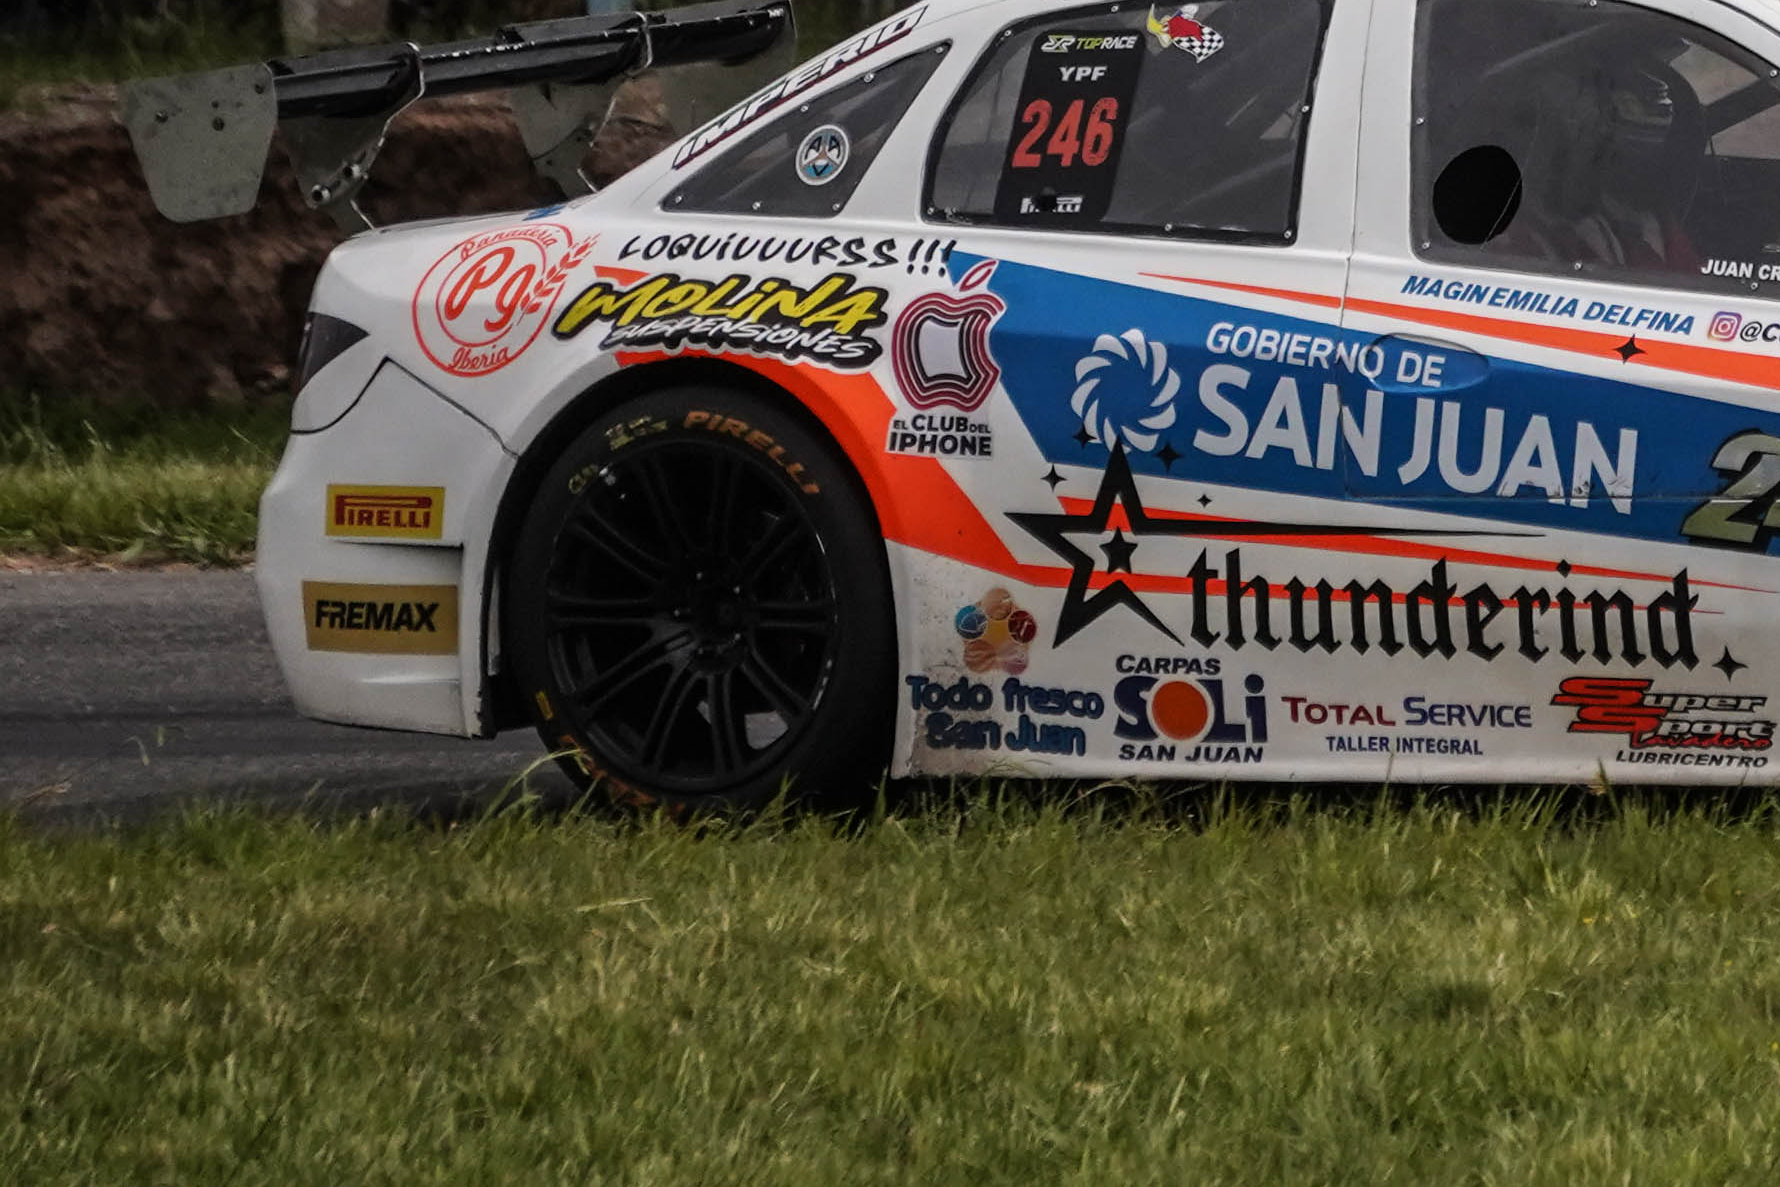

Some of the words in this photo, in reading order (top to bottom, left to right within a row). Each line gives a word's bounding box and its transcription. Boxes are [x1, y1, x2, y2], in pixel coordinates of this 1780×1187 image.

[1059, 66, 1107, 81] YPF
[1012, 97, 1119, 167] 246
[1700, 259, 1752, 279] JUAN
[1488, 287, 1579, 319] EMILIA
[1583, 301, 1696, 336] DELFINA
[452, 344, 509, 371] Iberia
[1205, 320, 1386, 381] GOBIERNO
[1397, 349, 1447, 388] DE
[893, 420, 908, 431] EL
[911, 414, 968, 432] CLUB
[969, 422, 992, 433] DEL
[889, 433, 992, 456] IPHONE
[1192, 364, 1386, 478] SAN
[1398, 397, 1638, 515] JUAN
[335, 495, 432, 529] PIRELLI
[315, 599, 440, 632] FREMAX
[1188, 547, 1700, 672] thunderind
[1115, 654, 1221, 675] CARPAS
[904, 675, 993, 711] Todo
[1002, 677, 1104, 719] fresco
[925, 711, 1001, 750] San
[1004, 714, 1087, 757] Juan
[1325, 736, 1390, 753] TALLER
[1395, 737, 1483, 756] INTEGRAL
[1119, 744, 1177, 762] SAN
[1185, 745, 1264, 763] JUAN
[1616, 750, 1768, 768] LUBRICENTRO
